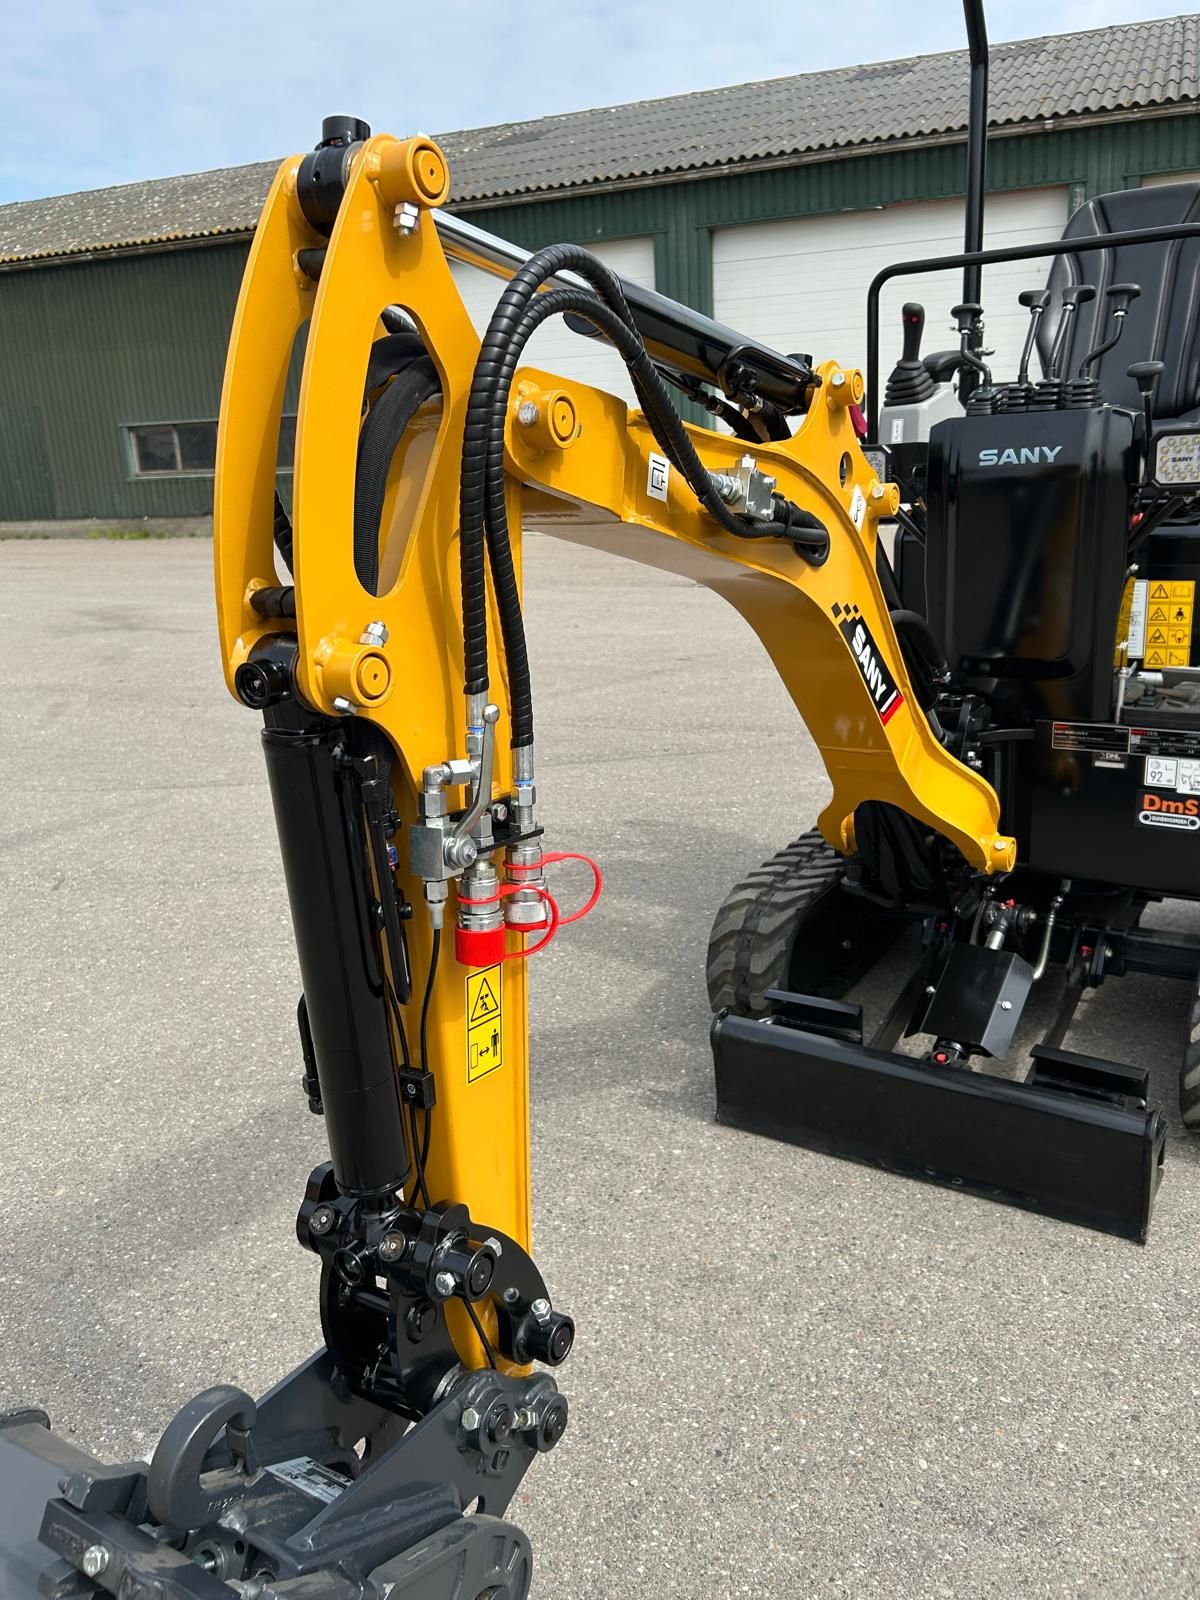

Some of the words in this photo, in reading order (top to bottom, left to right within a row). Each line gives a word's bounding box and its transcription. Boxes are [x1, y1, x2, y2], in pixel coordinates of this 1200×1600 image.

[979, 445, 1063, 467] SANY
[852, 624, 887, 702] SANY
[1150, 770, 1163, 783] 92
[1143, 793, 1199, 816] DmS
